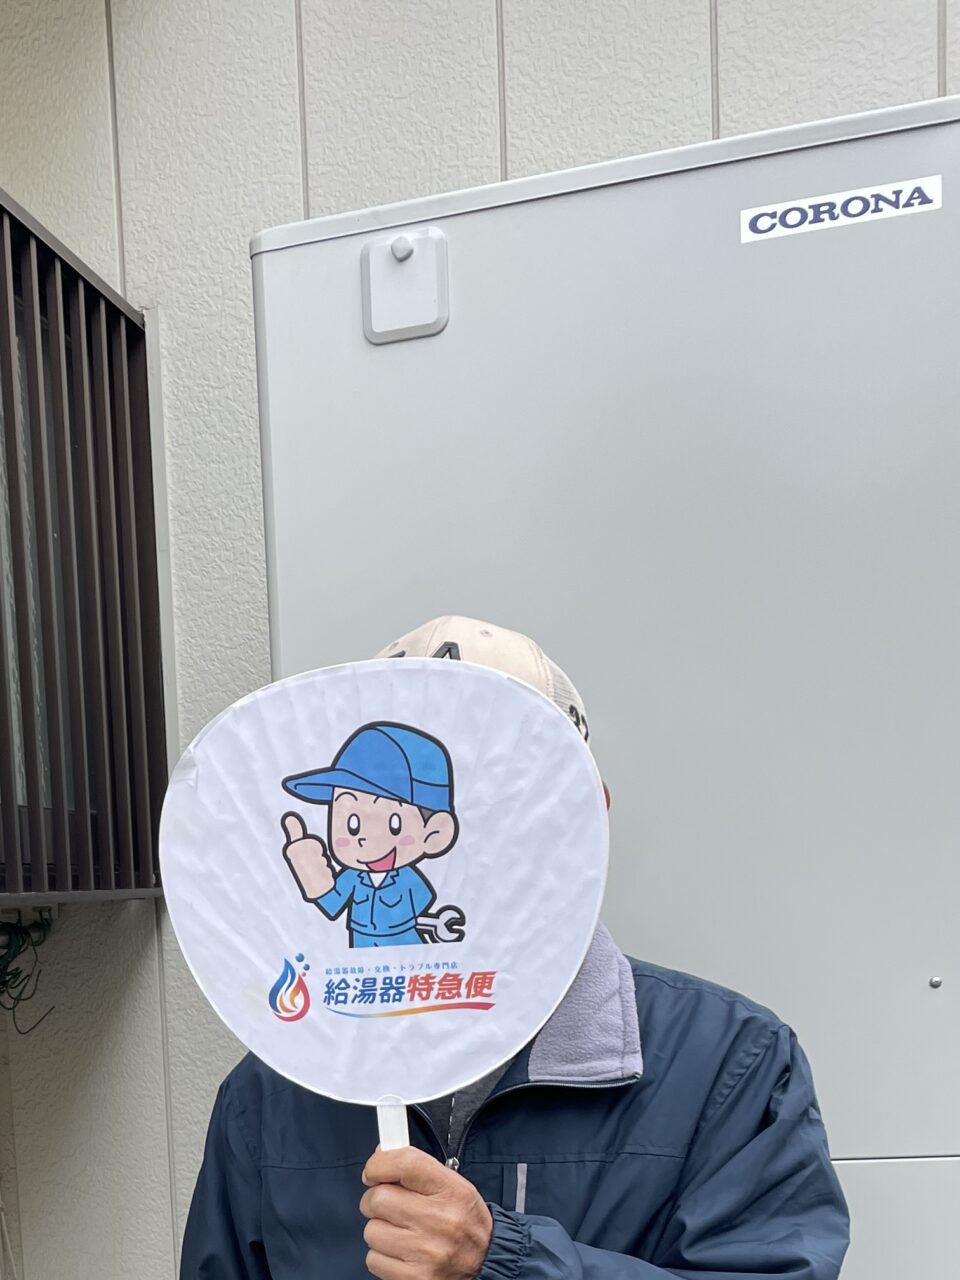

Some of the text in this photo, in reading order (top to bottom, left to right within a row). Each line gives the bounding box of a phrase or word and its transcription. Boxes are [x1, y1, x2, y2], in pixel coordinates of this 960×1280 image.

[748, 186, 934, 235] CORONA
[323, 970, 497, 1006] 給湯器特急便
